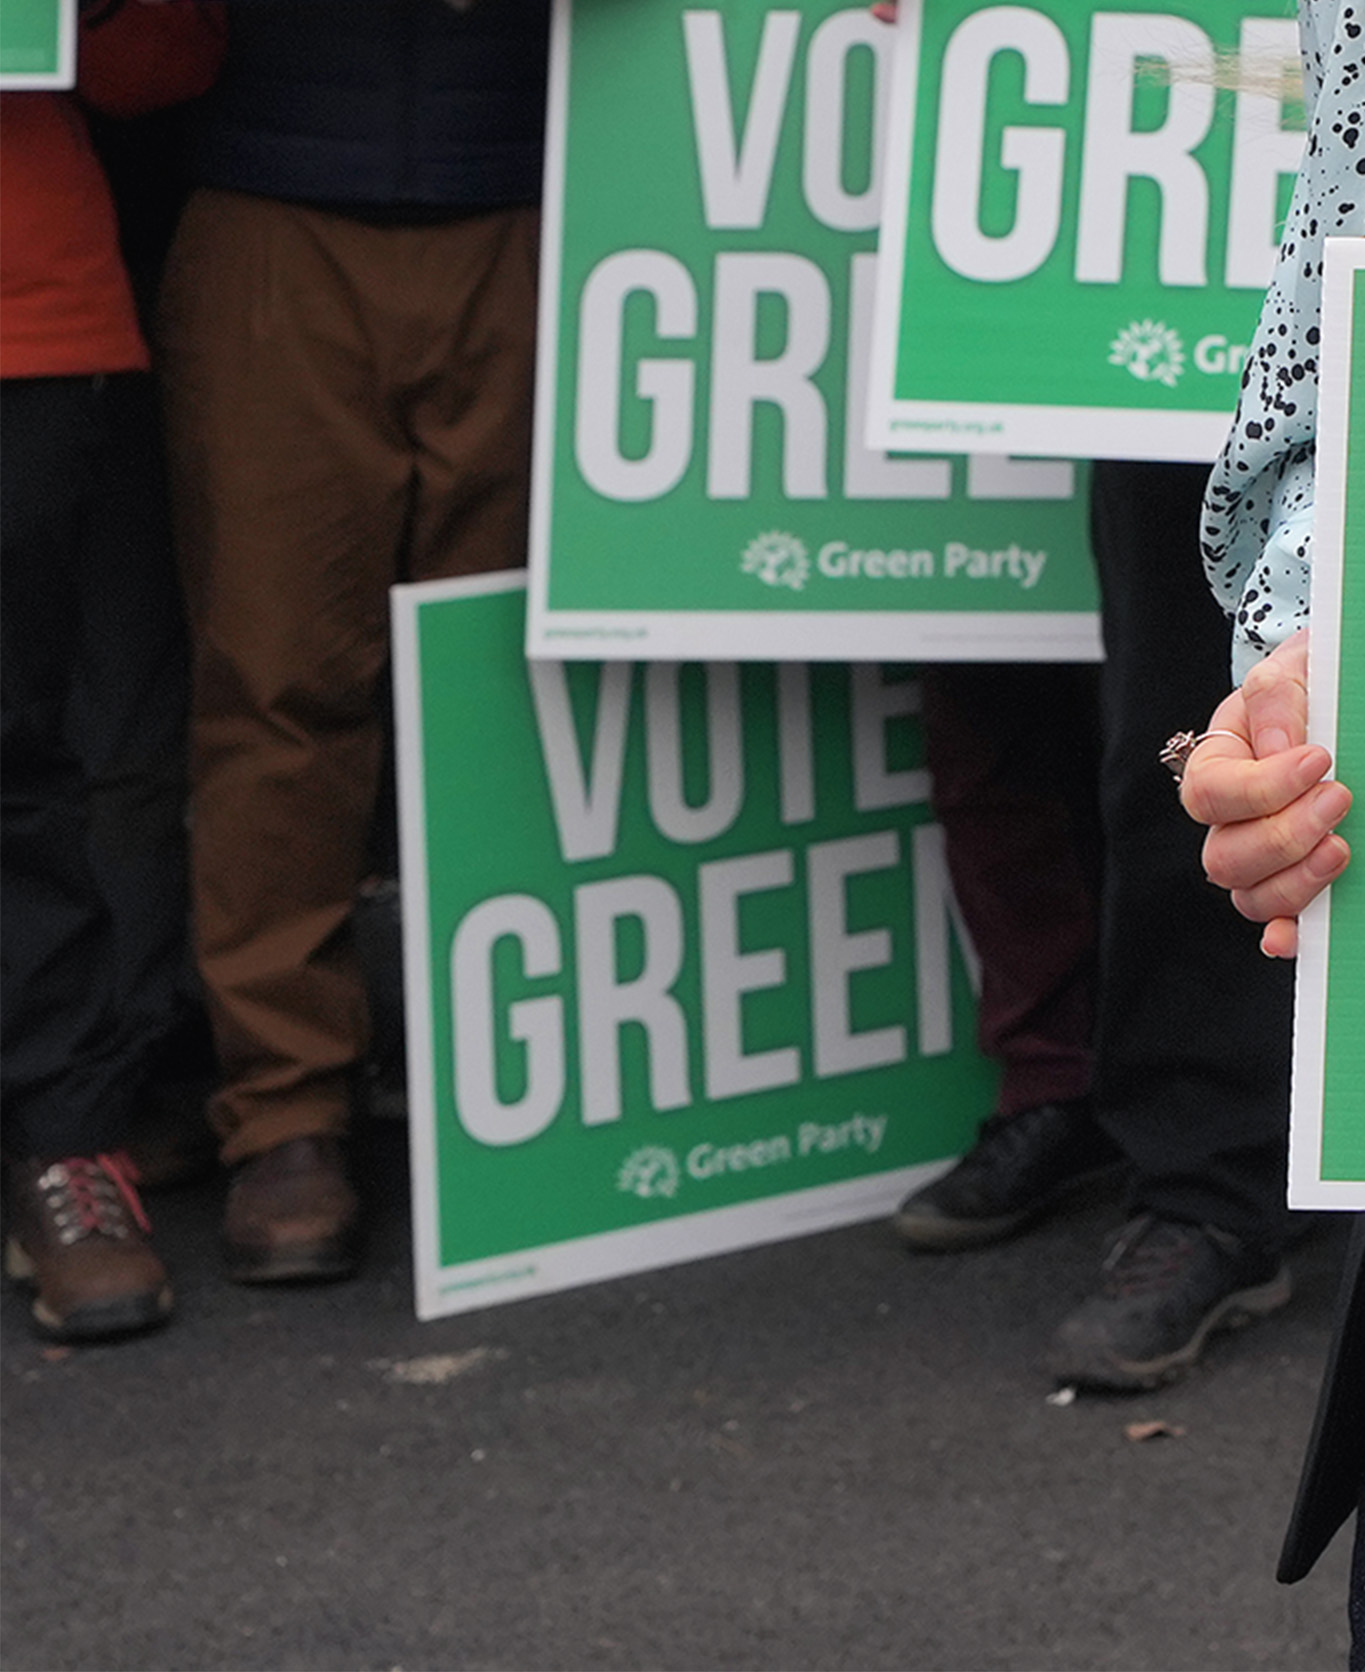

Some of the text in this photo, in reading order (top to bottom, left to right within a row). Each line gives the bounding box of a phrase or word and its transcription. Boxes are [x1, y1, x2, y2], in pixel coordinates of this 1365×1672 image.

[818, 543, 1047, 589] Green Party
[687, 1115, 888, 1181] Green Party
